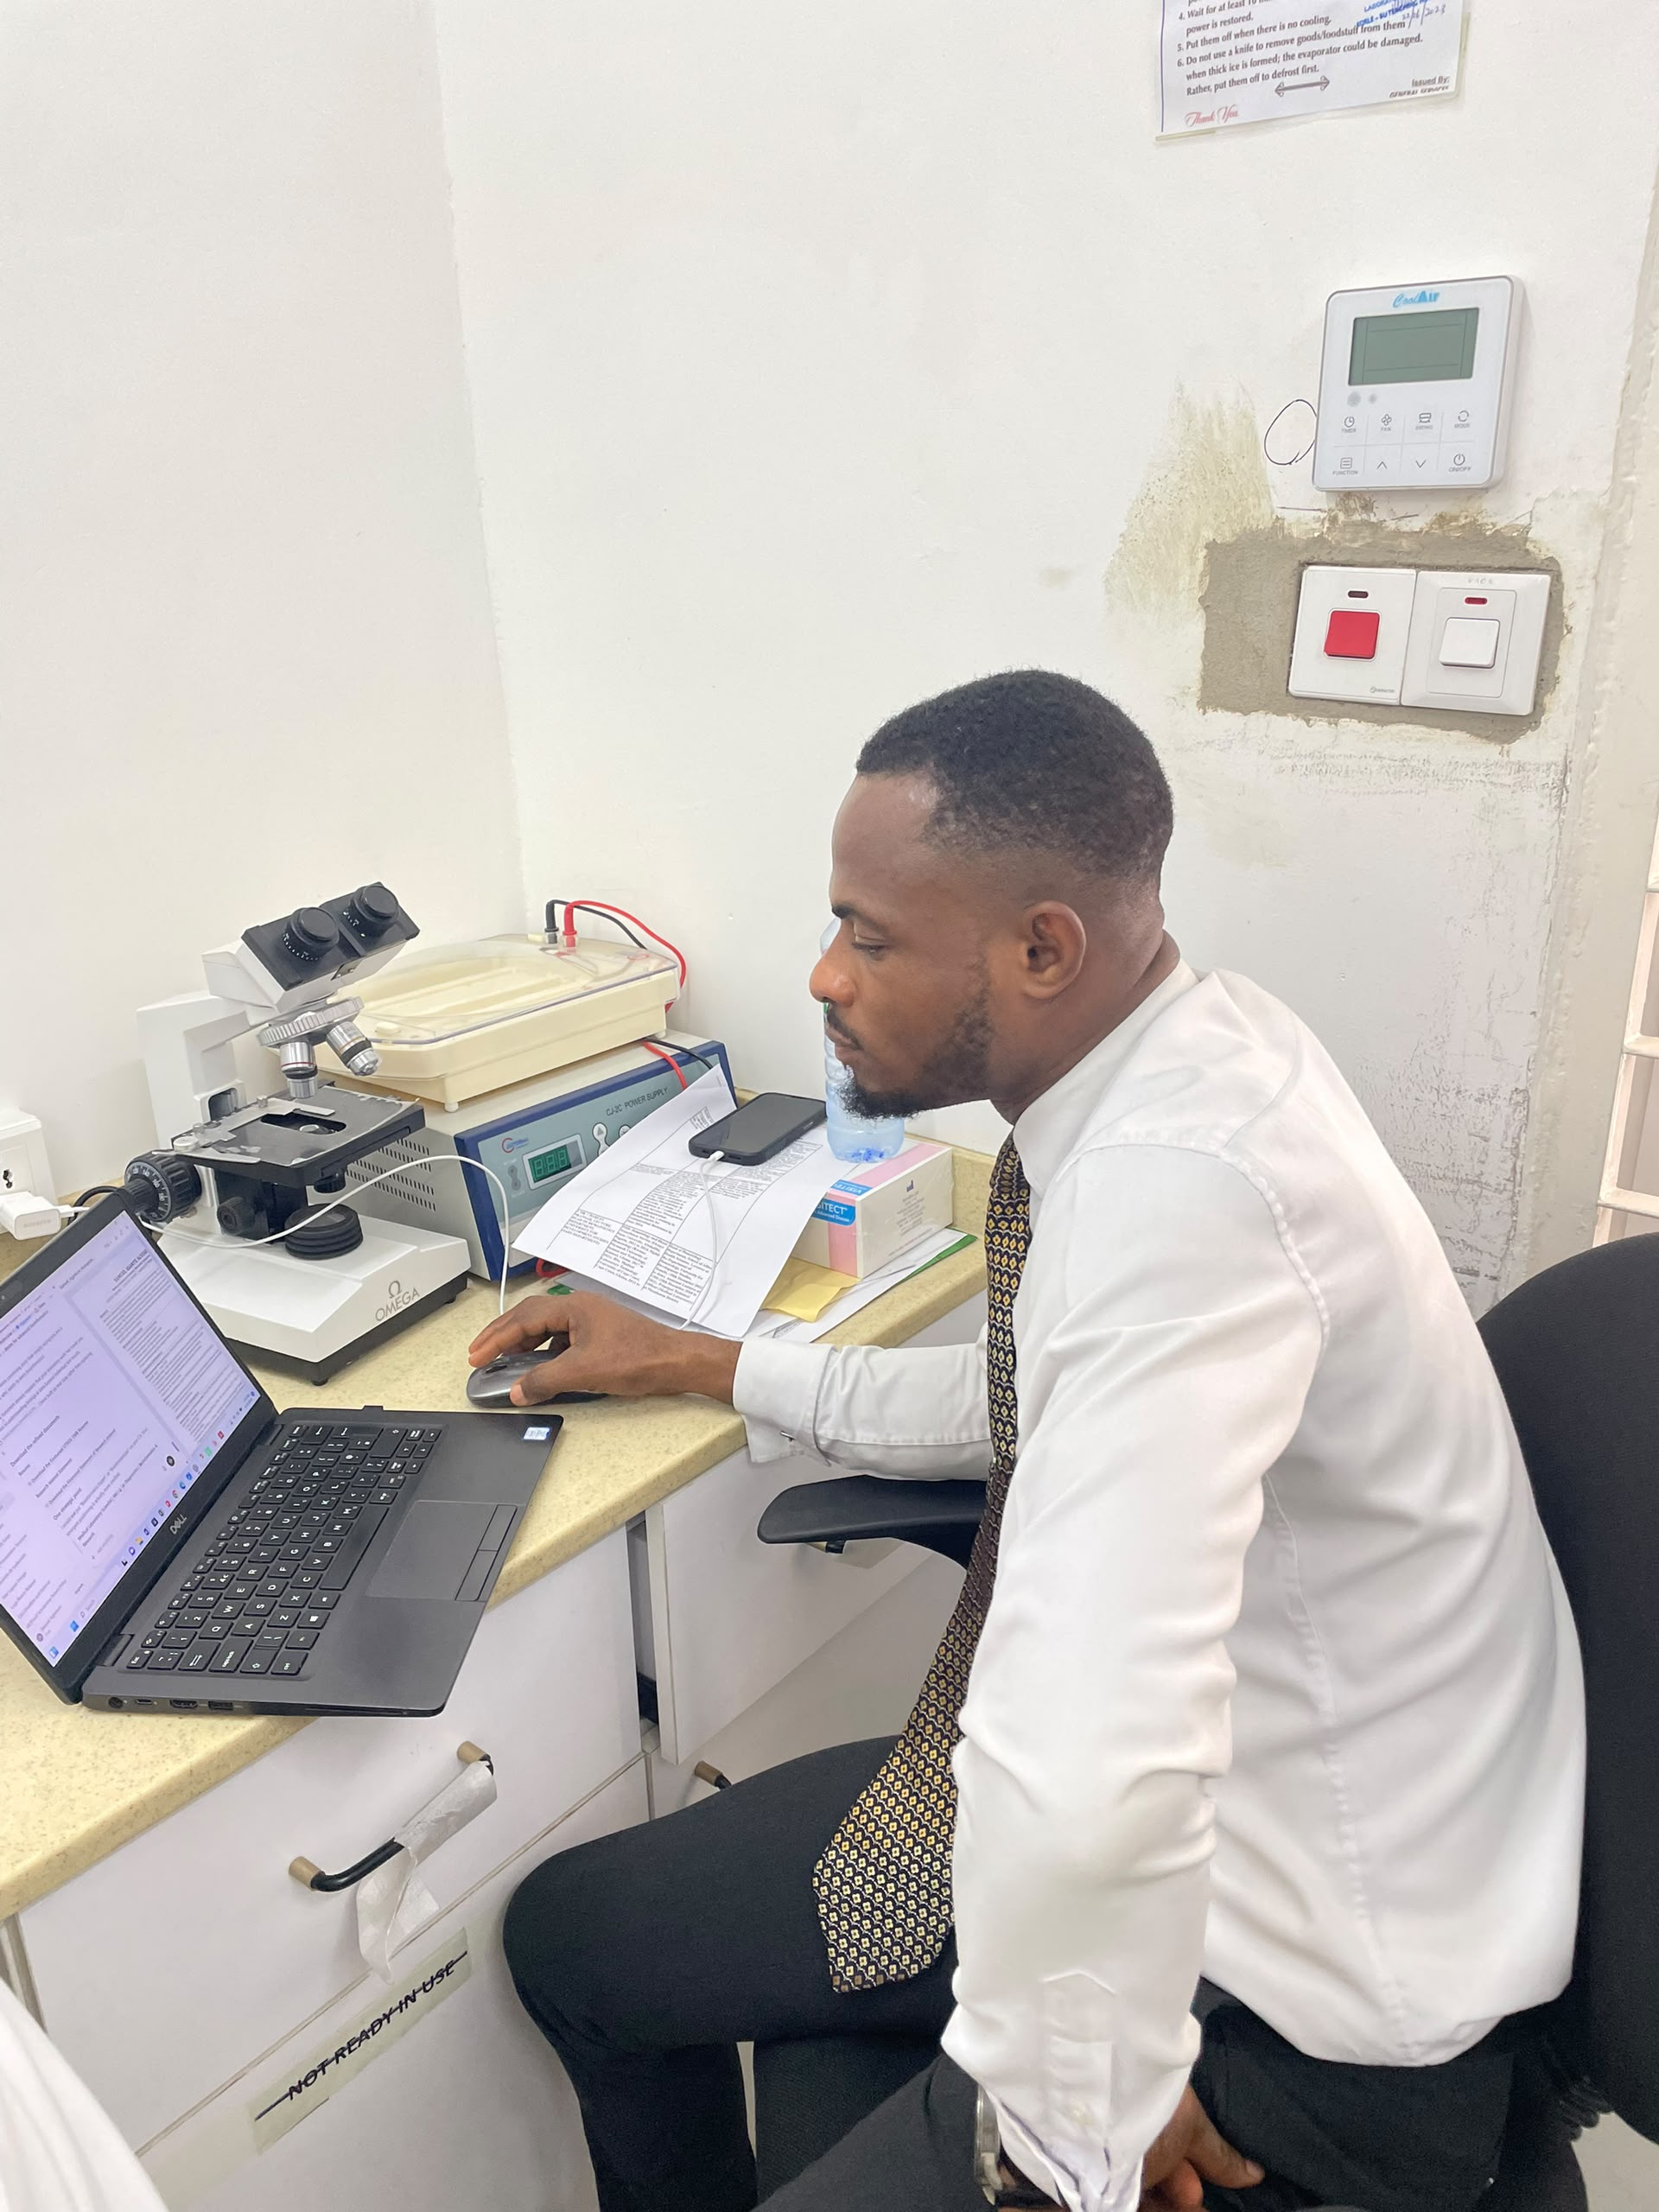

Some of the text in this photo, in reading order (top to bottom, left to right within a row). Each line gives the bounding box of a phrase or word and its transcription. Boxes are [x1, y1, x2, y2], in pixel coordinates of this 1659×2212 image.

[1187, 9, 1204, 18] Wait
[1206, 5, 1217, 14] for
[1228, 0, 1245, 10] least
[1185, 12, 1253, 37] power is restored.
[1200, 36, 1220, 47] them
[1222, 31, 1232, 41] off
[1234, 29, 1255, 39] when
[1256, 25, 1277, 35] there
[1279, 22, 1286, 30] is
[1185, 56, 1197, 66] Do
[1199, 53, 1211, 63] not
[1213, 51, 1226, 60] use
[1235, 42, 1254, 55] knife
[1265, 37, 1295, 49] remove
[1297, 24, 1358, 46] goods/foodstuff
[1361, 24, 1381, 33] from
[1382, 21, 1406, 30] them
[1185, 33, 1423, 81] when thick ice is formed; the evaporator could be damaged.
[1186, 65, 1319, 96] Rather, put them off to defrost first.
[1411, 76, 1437, 87] Issued
[1185, 111, 1216, 127] Thank
[624, 1095, 646, 1109] POWER
[646, 1087, 668, 1101] SUPPLY
[375, 1287, 421, 1322] OMEGA
[169, 1513, 188, 1535] DELL
[223, 1605, 233, 1613] W
[288, 1960, 455, 2101] NOT READY IN USE
